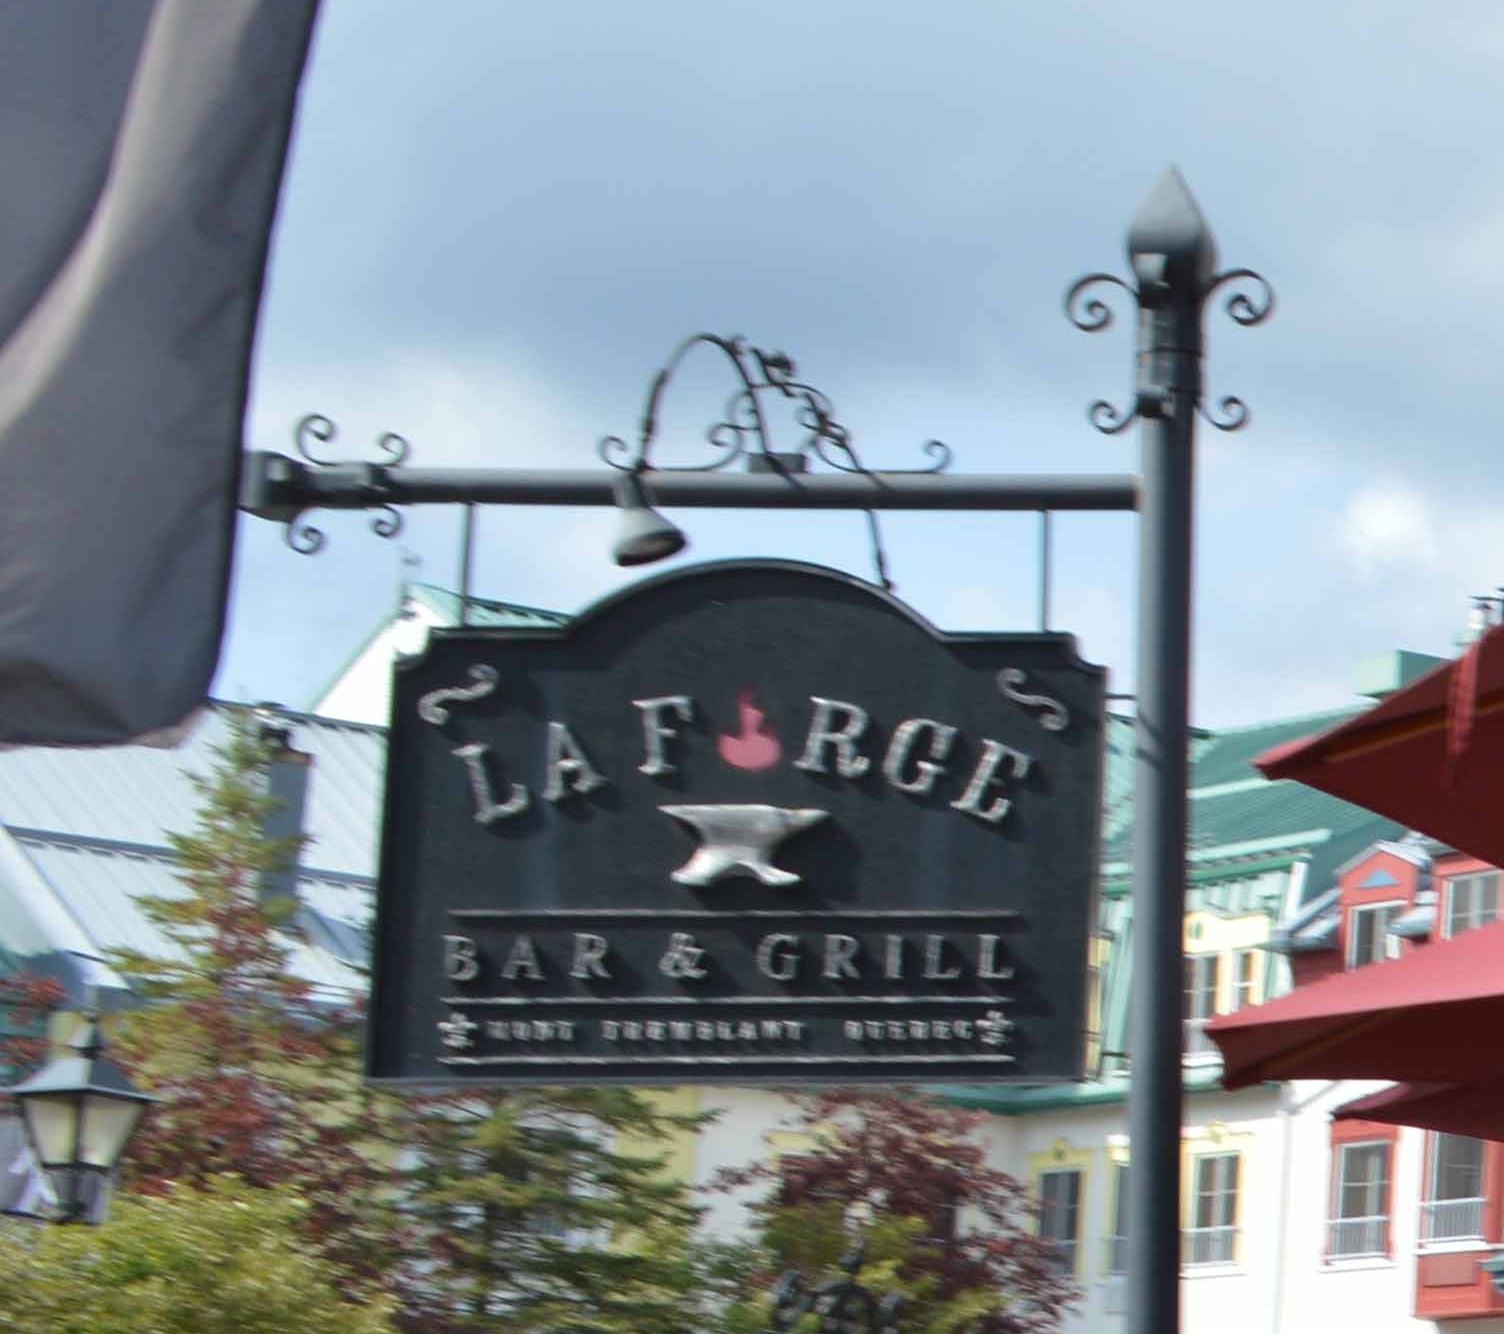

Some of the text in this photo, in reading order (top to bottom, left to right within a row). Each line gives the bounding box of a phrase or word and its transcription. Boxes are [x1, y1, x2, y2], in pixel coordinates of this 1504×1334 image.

[452, 694, 1033, 825] LA FRGE
[440, 931, 1014, 982] BAR & GRILL
[485, 1019, 576, 1042] MONT
[600, 1018, 805, 1042] TREMBLANT
